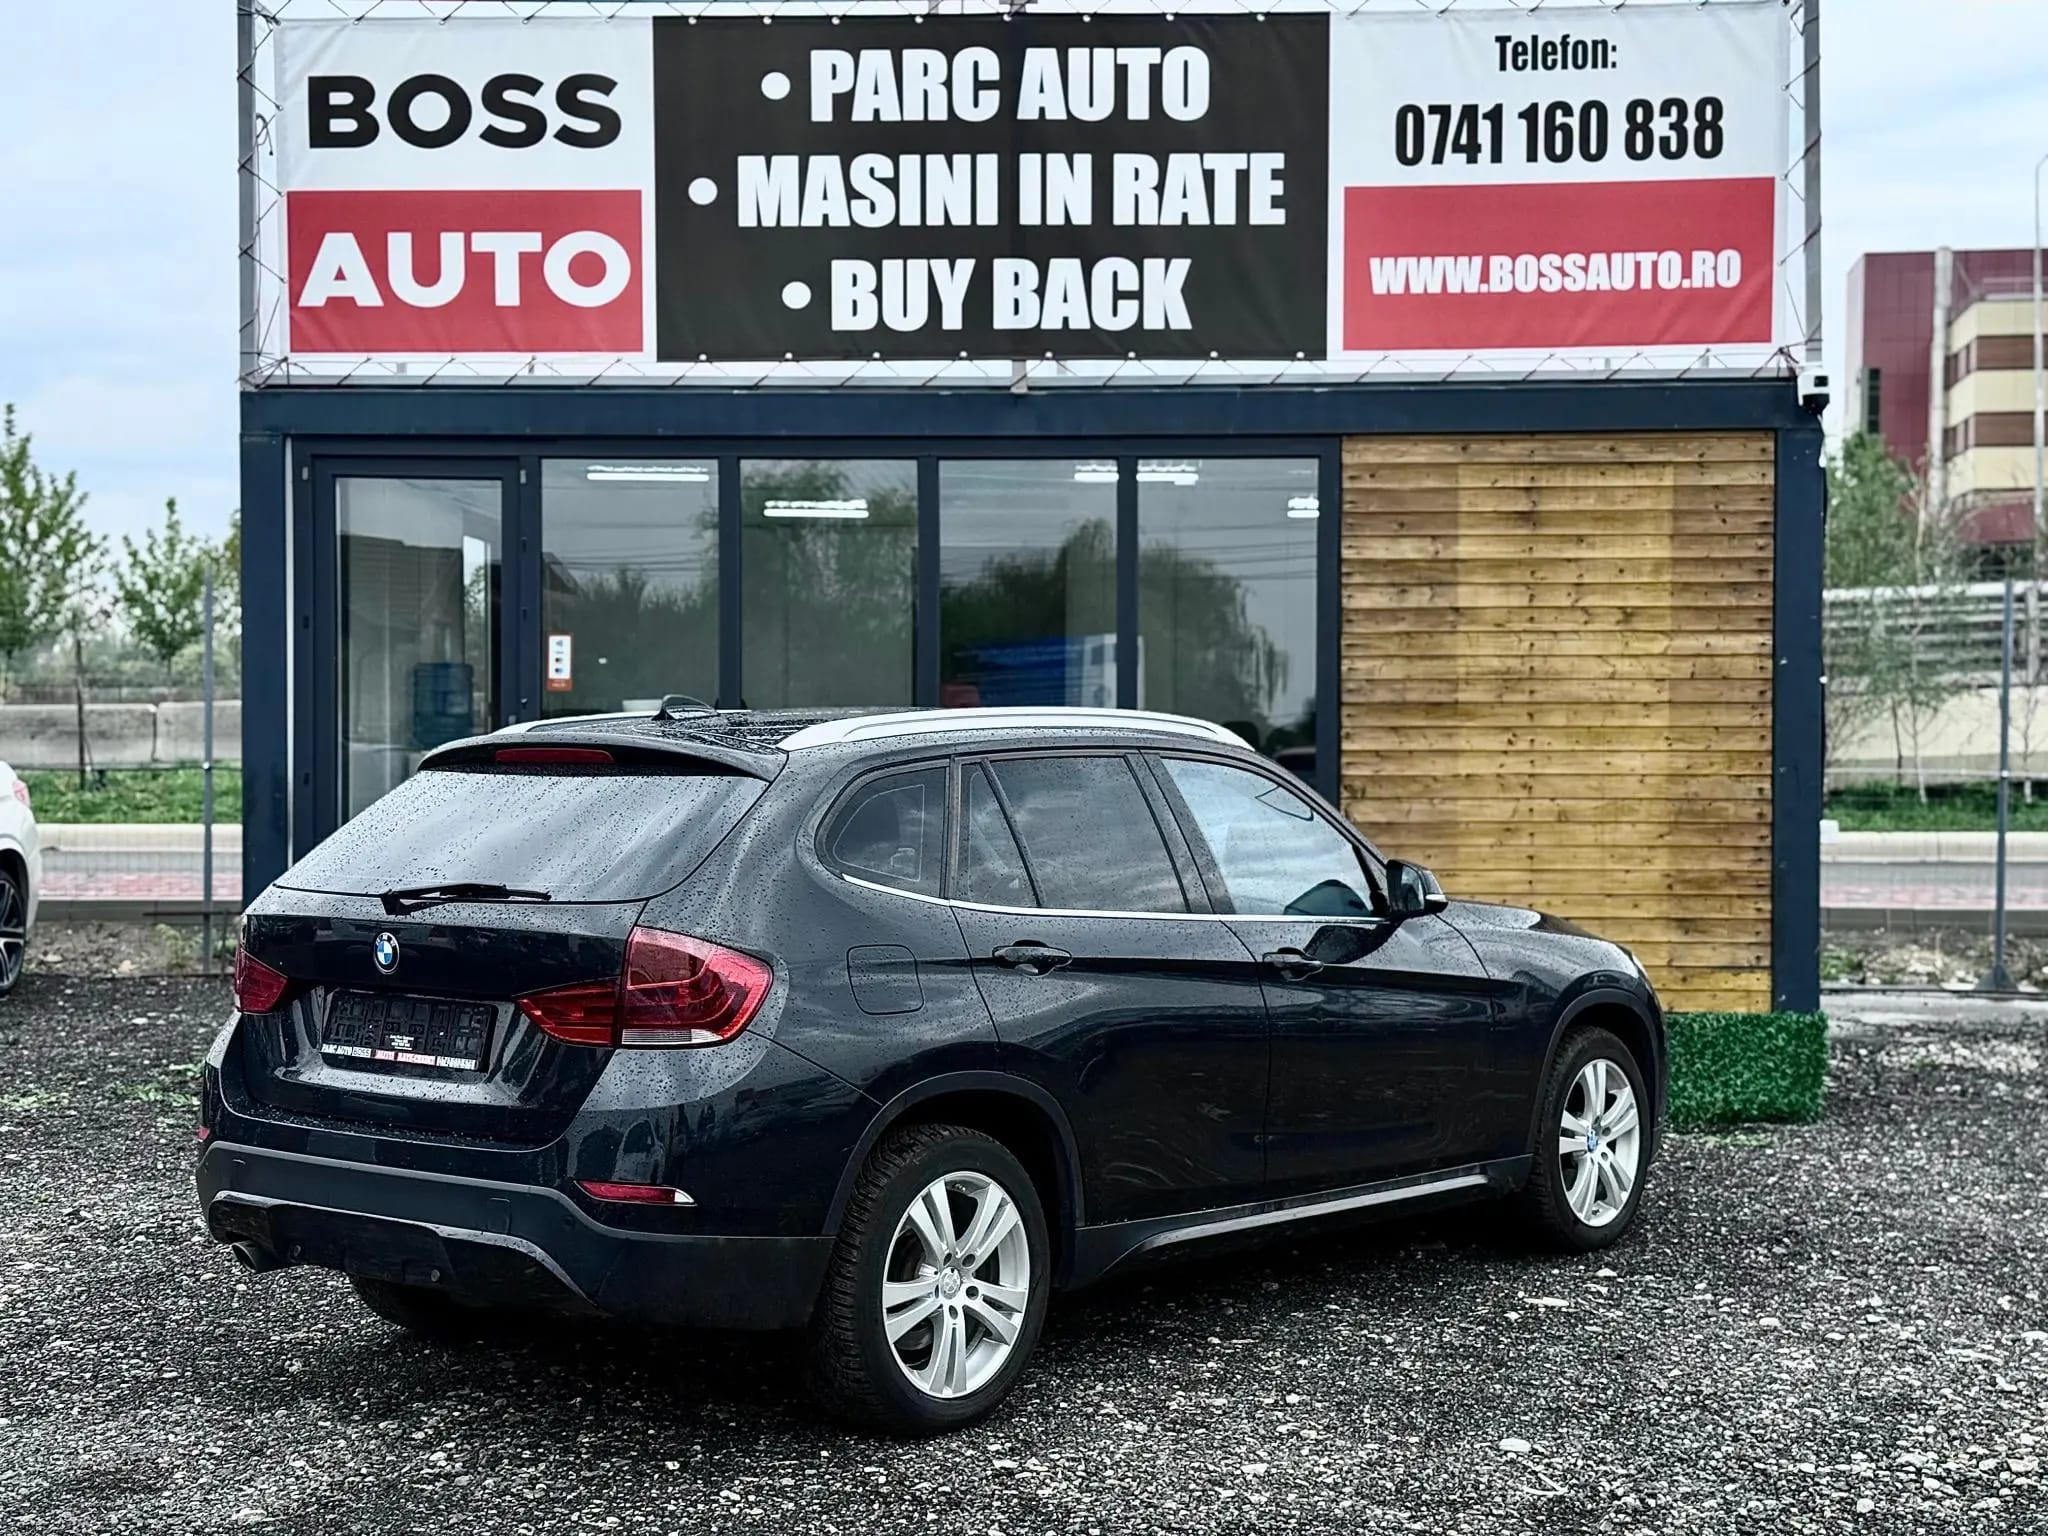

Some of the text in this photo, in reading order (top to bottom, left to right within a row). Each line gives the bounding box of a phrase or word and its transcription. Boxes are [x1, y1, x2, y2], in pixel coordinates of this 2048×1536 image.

[811, 46, 1210, 122] PARC AUTO
[1495, 34, 1617, 71] Telefon:
[307, 73, 622, 150] BOSS
[1395, 97, 1724, 166] 0741 160 838
[737, 153, 1286, 228] MASINI IN RATE
[298, 231, 632, 308] AUTO
[831, 257, 1193, 332] BUY BACK
[1370, 249, 1742, 295] WWW.BOSSAUTO.RO
